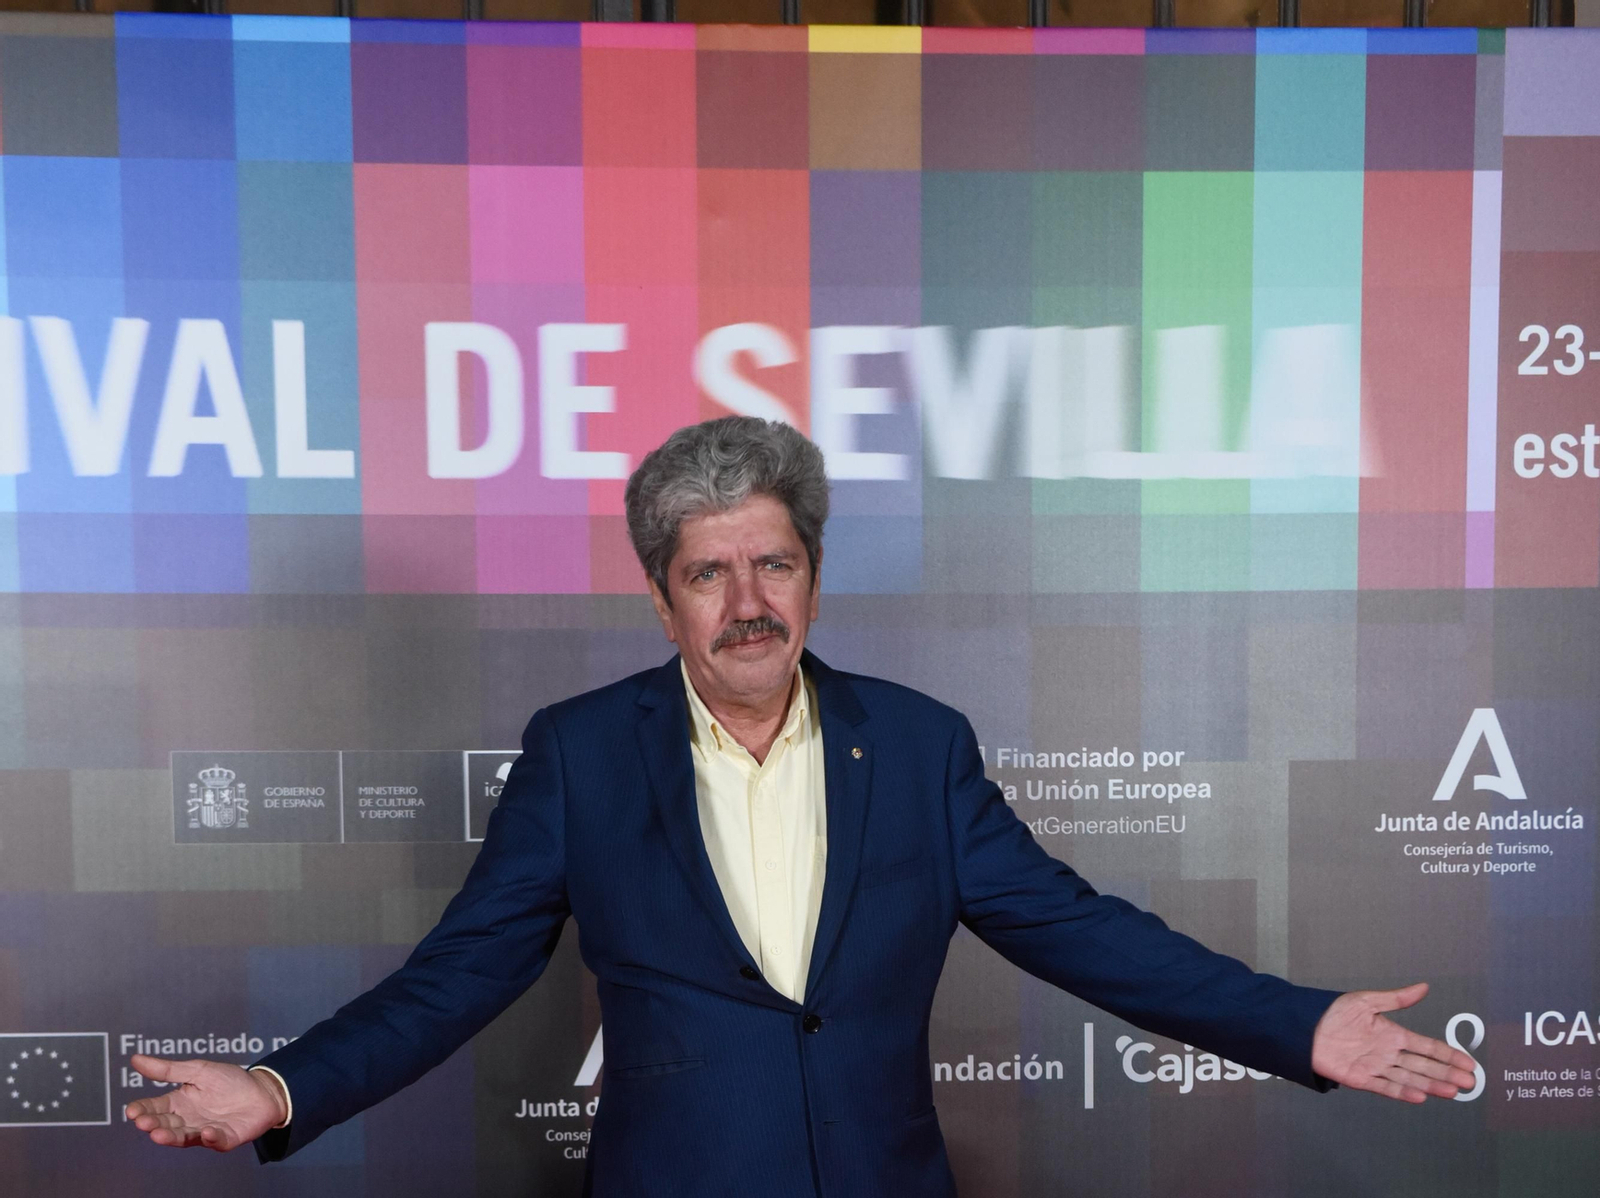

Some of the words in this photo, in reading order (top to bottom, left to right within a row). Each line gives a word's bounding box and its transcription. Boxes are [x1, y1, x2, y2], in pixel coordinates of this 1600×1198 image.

[1517, 324, 1600, 376] 23-
[424, 320, 631, 480] DE
[1513, 424, 1600, 479] est
[997, 746, 1134, 769] Financiado
[1143, 750, 1185, 771] por
[264, 787, 325, 797] GOBIERNO
[358, 786, 418, 796] MINISTERIO
[1026, 779, 1099, 801] Unión
[1108, 778, 1212, 803] Europea
[264, 799, 280, 808] DE
[283, 796, 325, 808] ESPAÑA
[359, 798, 373, 807] DE
[376, 798, 425, 807] CULTURA
[360, 810, 366, 819] Y
[369, 810, 416, 819] DEPORTE
[1374, 813, 1438, 832] Junta
[1443, 811, 1471, 831] de
[1475, 807, 1584, 831] Andalucía
[1403, 842, 1474, 858] Consejería
[1476, 843, 1494, 855] de
[1496, 842, 1553, 856] Turismo,
[1420, 861, 1470, 874] Cultura
[1473, 863, 1480, 876] y
[1483, 861, 1536, 875] Deporte
[1525, 1010, 1600, 1047] ICA
[120, 1033, 264, 1055] Financiado
[121, 1067, 144, 1088] la
[934, 1054, 1064, 1082] ndación
[1504, 1068, 1557, 1081] Instituto
[1560, 1068, 1577, 1080] de
[1581, 1068, 1591, 1080] la
[1506, 1089, 1514, 1101] y
[1518, 1086, 1536, 1098] las
[1540, 1086, 1574, 1098] Artes
[1577, 1085, 1594, 1097] de
[515, 1099, 580, 1118] Junta
[564, 1146, 588, 1159] Cul
